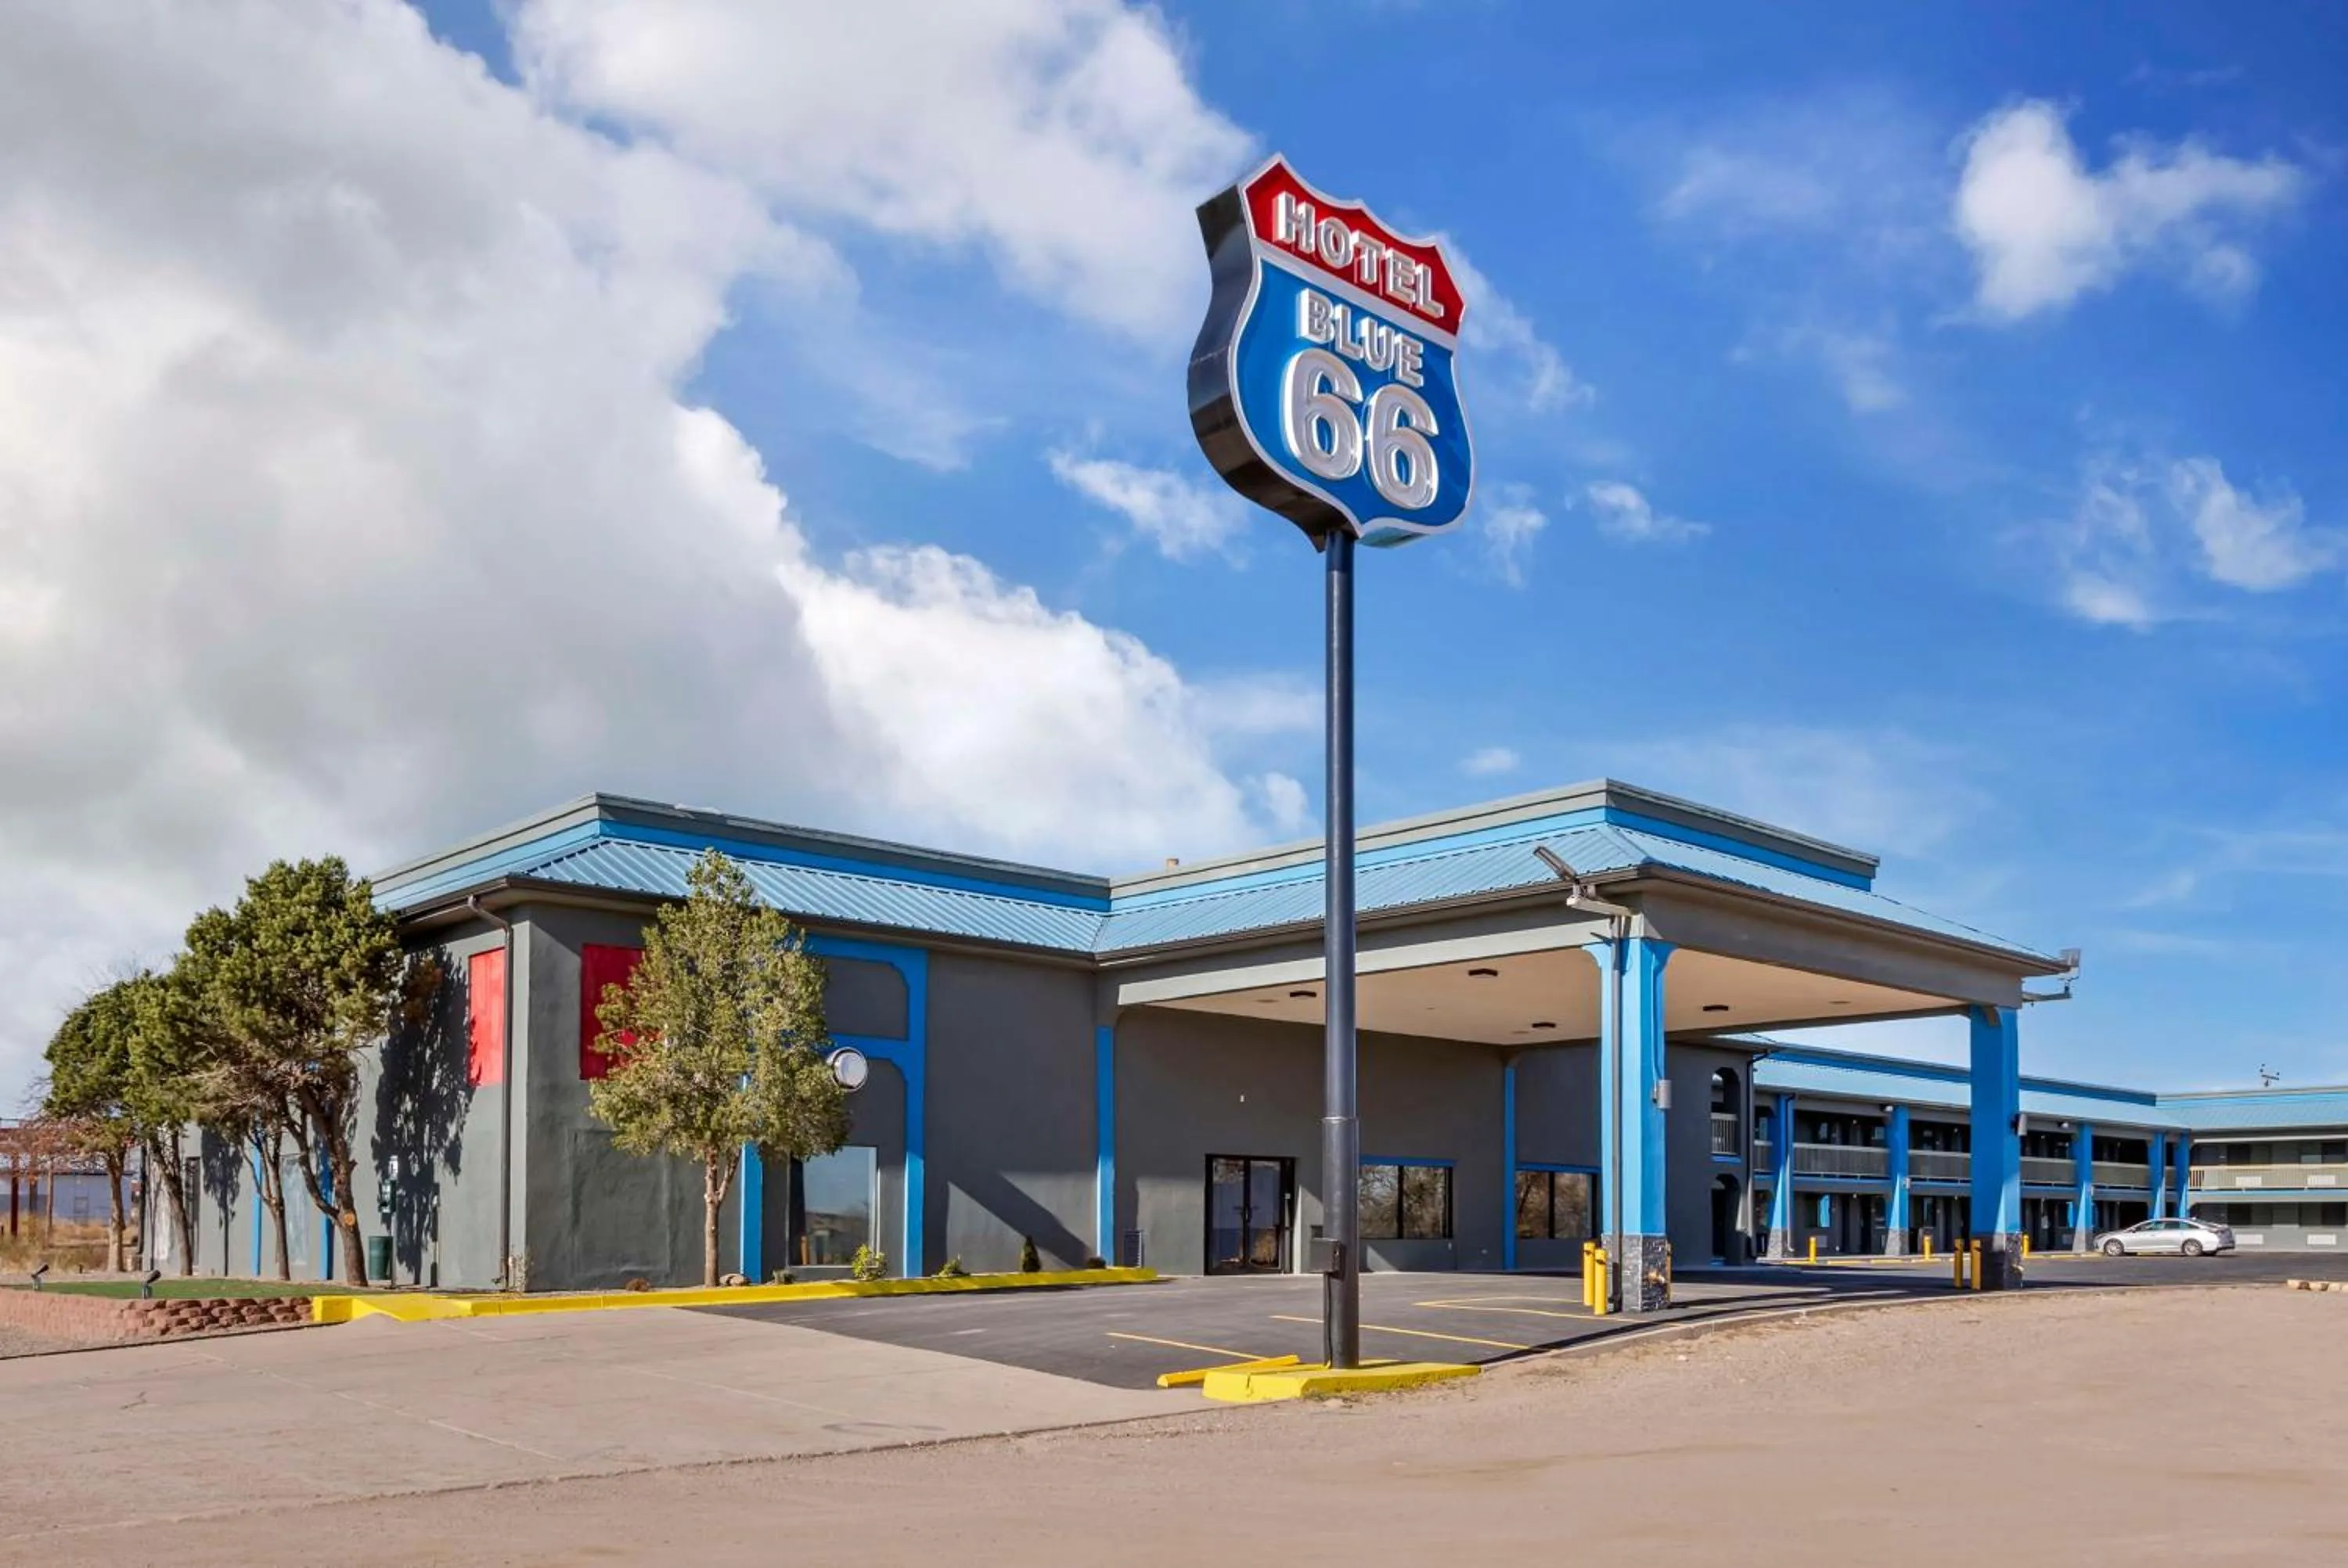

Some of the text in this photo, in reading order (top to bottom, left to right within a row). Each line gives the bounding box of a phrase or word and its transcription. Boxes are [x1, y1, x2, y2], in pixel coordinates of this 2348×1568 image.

[1274, 191, 1444, 318] HOTEL
[1297, 288, 1424, 387] BLUE
[1282, 348, 1439, 508] 66
